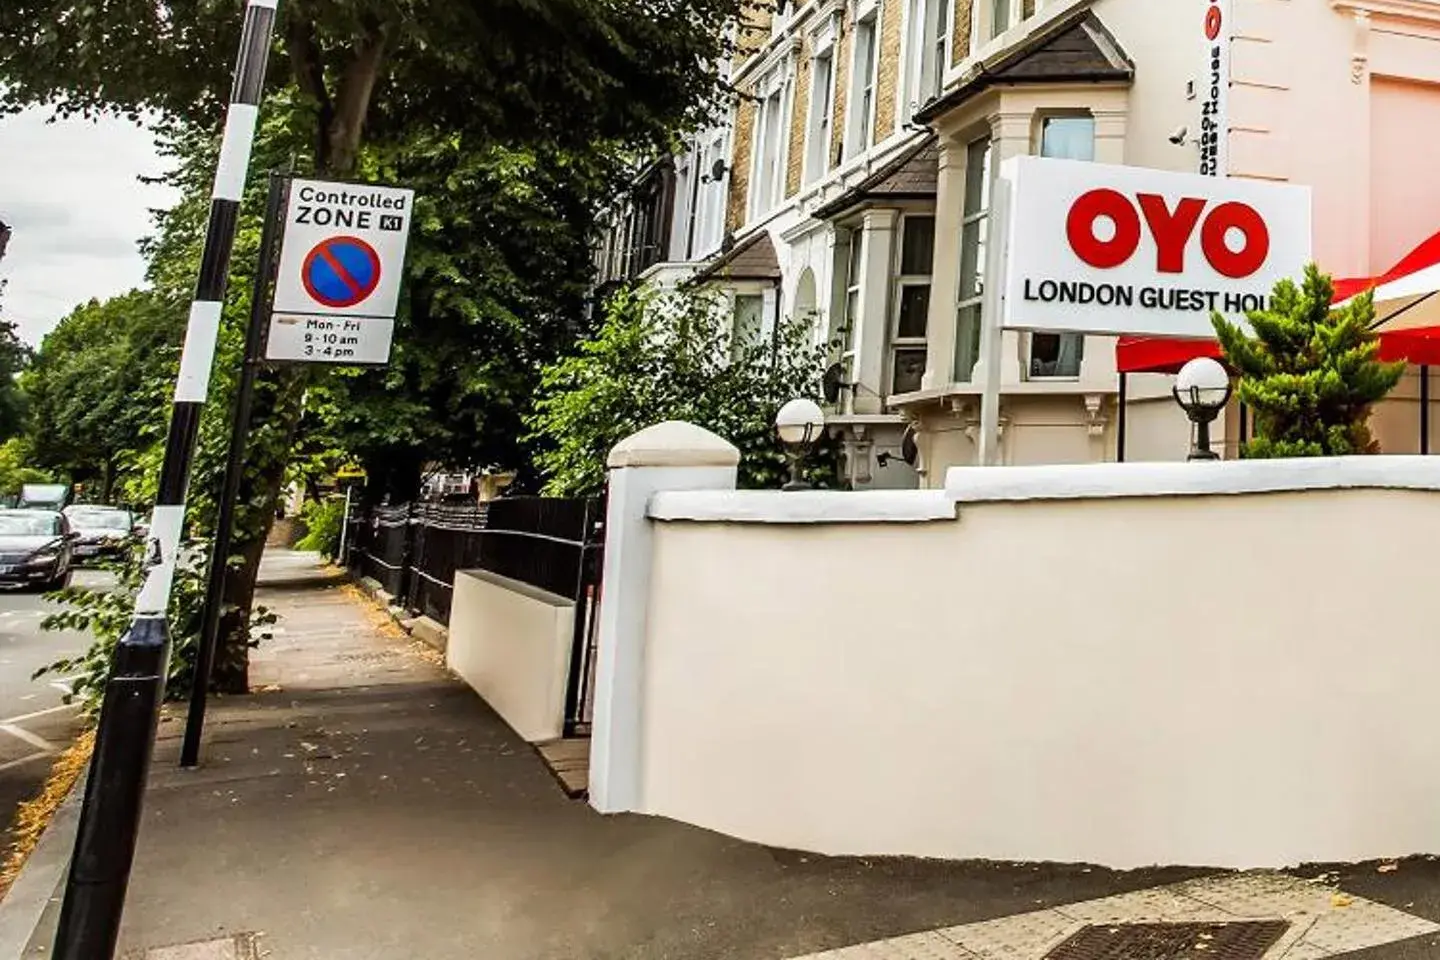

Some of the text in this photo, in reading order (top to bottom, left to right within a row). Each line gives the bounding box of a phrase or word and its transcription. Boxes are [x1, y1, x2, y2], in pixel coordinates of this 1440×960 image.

[1200, 101, 1210, 176] ONDON
[299, 187, 406, 210] Controlled
[295, 206, 371, 229] ZONE
[1066, 188, 1270, 279] OYO
[1024, 279, 1275, 313] LONDON GUEST HOU
[306, 320, 333, 330] Mon
[343, 321, 360, 331] Fri
[323, 333, 337, 344] 10
[340, 336, 358, 344] am
[304, 345, 313, 356] 3
[323, 347, 332, 356] 4
[334, 348, 354, 358] pm
